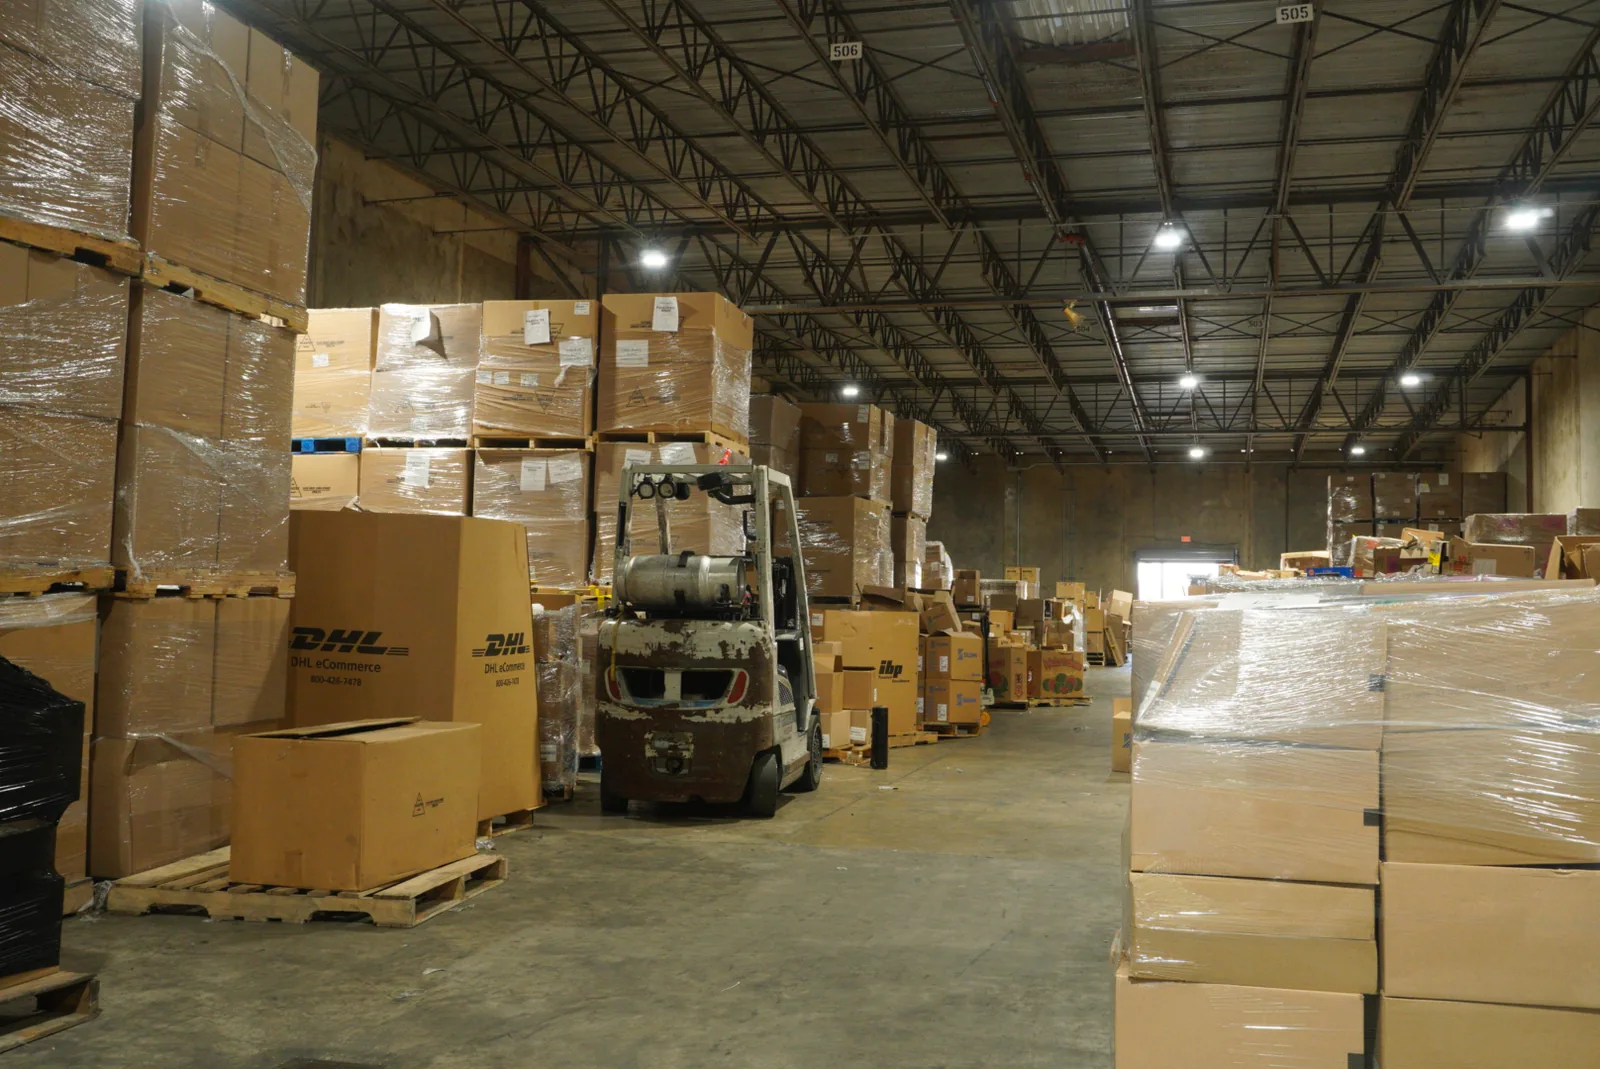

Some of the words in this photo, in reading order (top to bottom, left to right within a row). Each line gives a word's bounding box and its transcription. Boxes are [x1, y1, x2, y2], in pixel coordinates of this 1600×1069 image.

[1281, 6, 1309, 20] 505
[834, 45, 858, 57] 506
[290, 627, 388, 655] DHL
[484, 632, 526, 656] DHL
[291, 656, 312, 668] DHL
[316, 658, 381, 672] eCommerce
[485, 663, 498, 673] DHL
[879, 659, 903, 679] ibp
